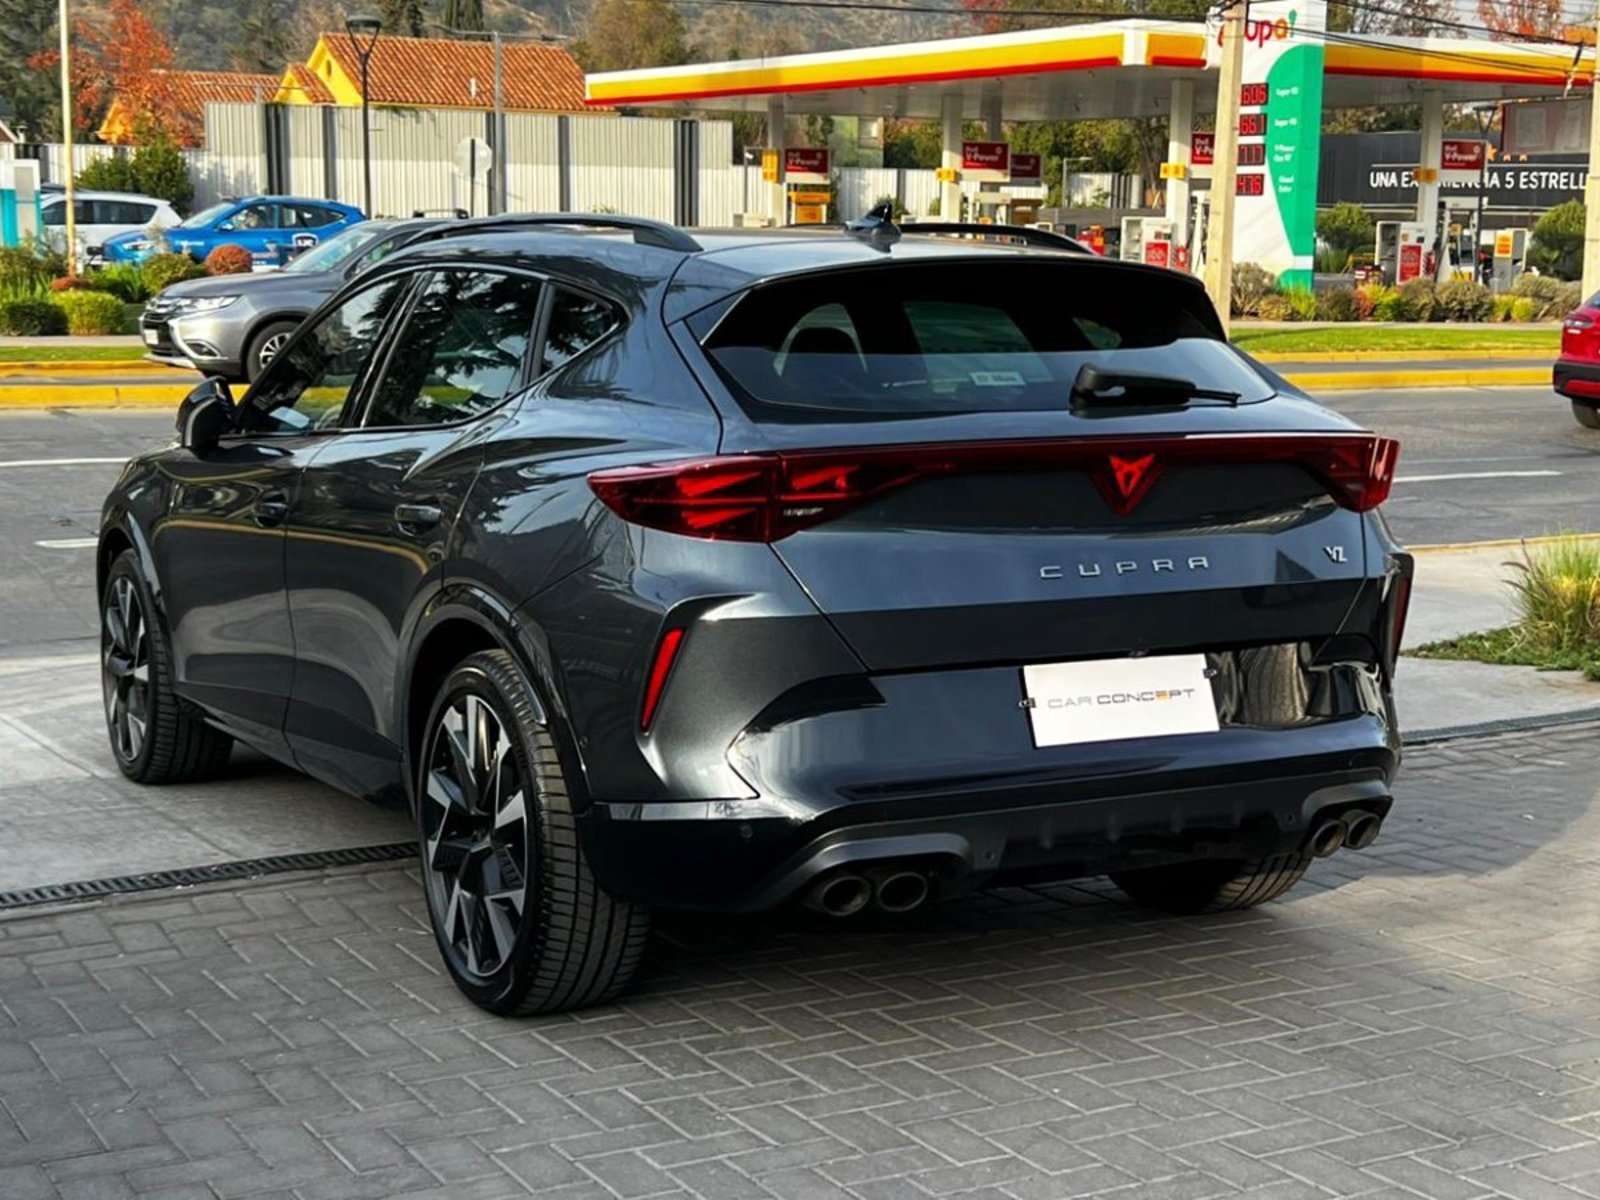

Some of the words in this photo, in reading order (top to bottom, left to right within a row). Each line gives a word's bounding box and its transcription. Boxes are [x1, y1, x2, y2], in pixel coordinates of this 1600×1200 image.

[1370, 171, 1397, 188] UNA
[1505, 171, 1515, 189] 5
[1040, 556, 1209, 578] CUPRA
[1048, 696, 1092, 709] CAR
[1096, 689, 1195, 705] CONCEPT
